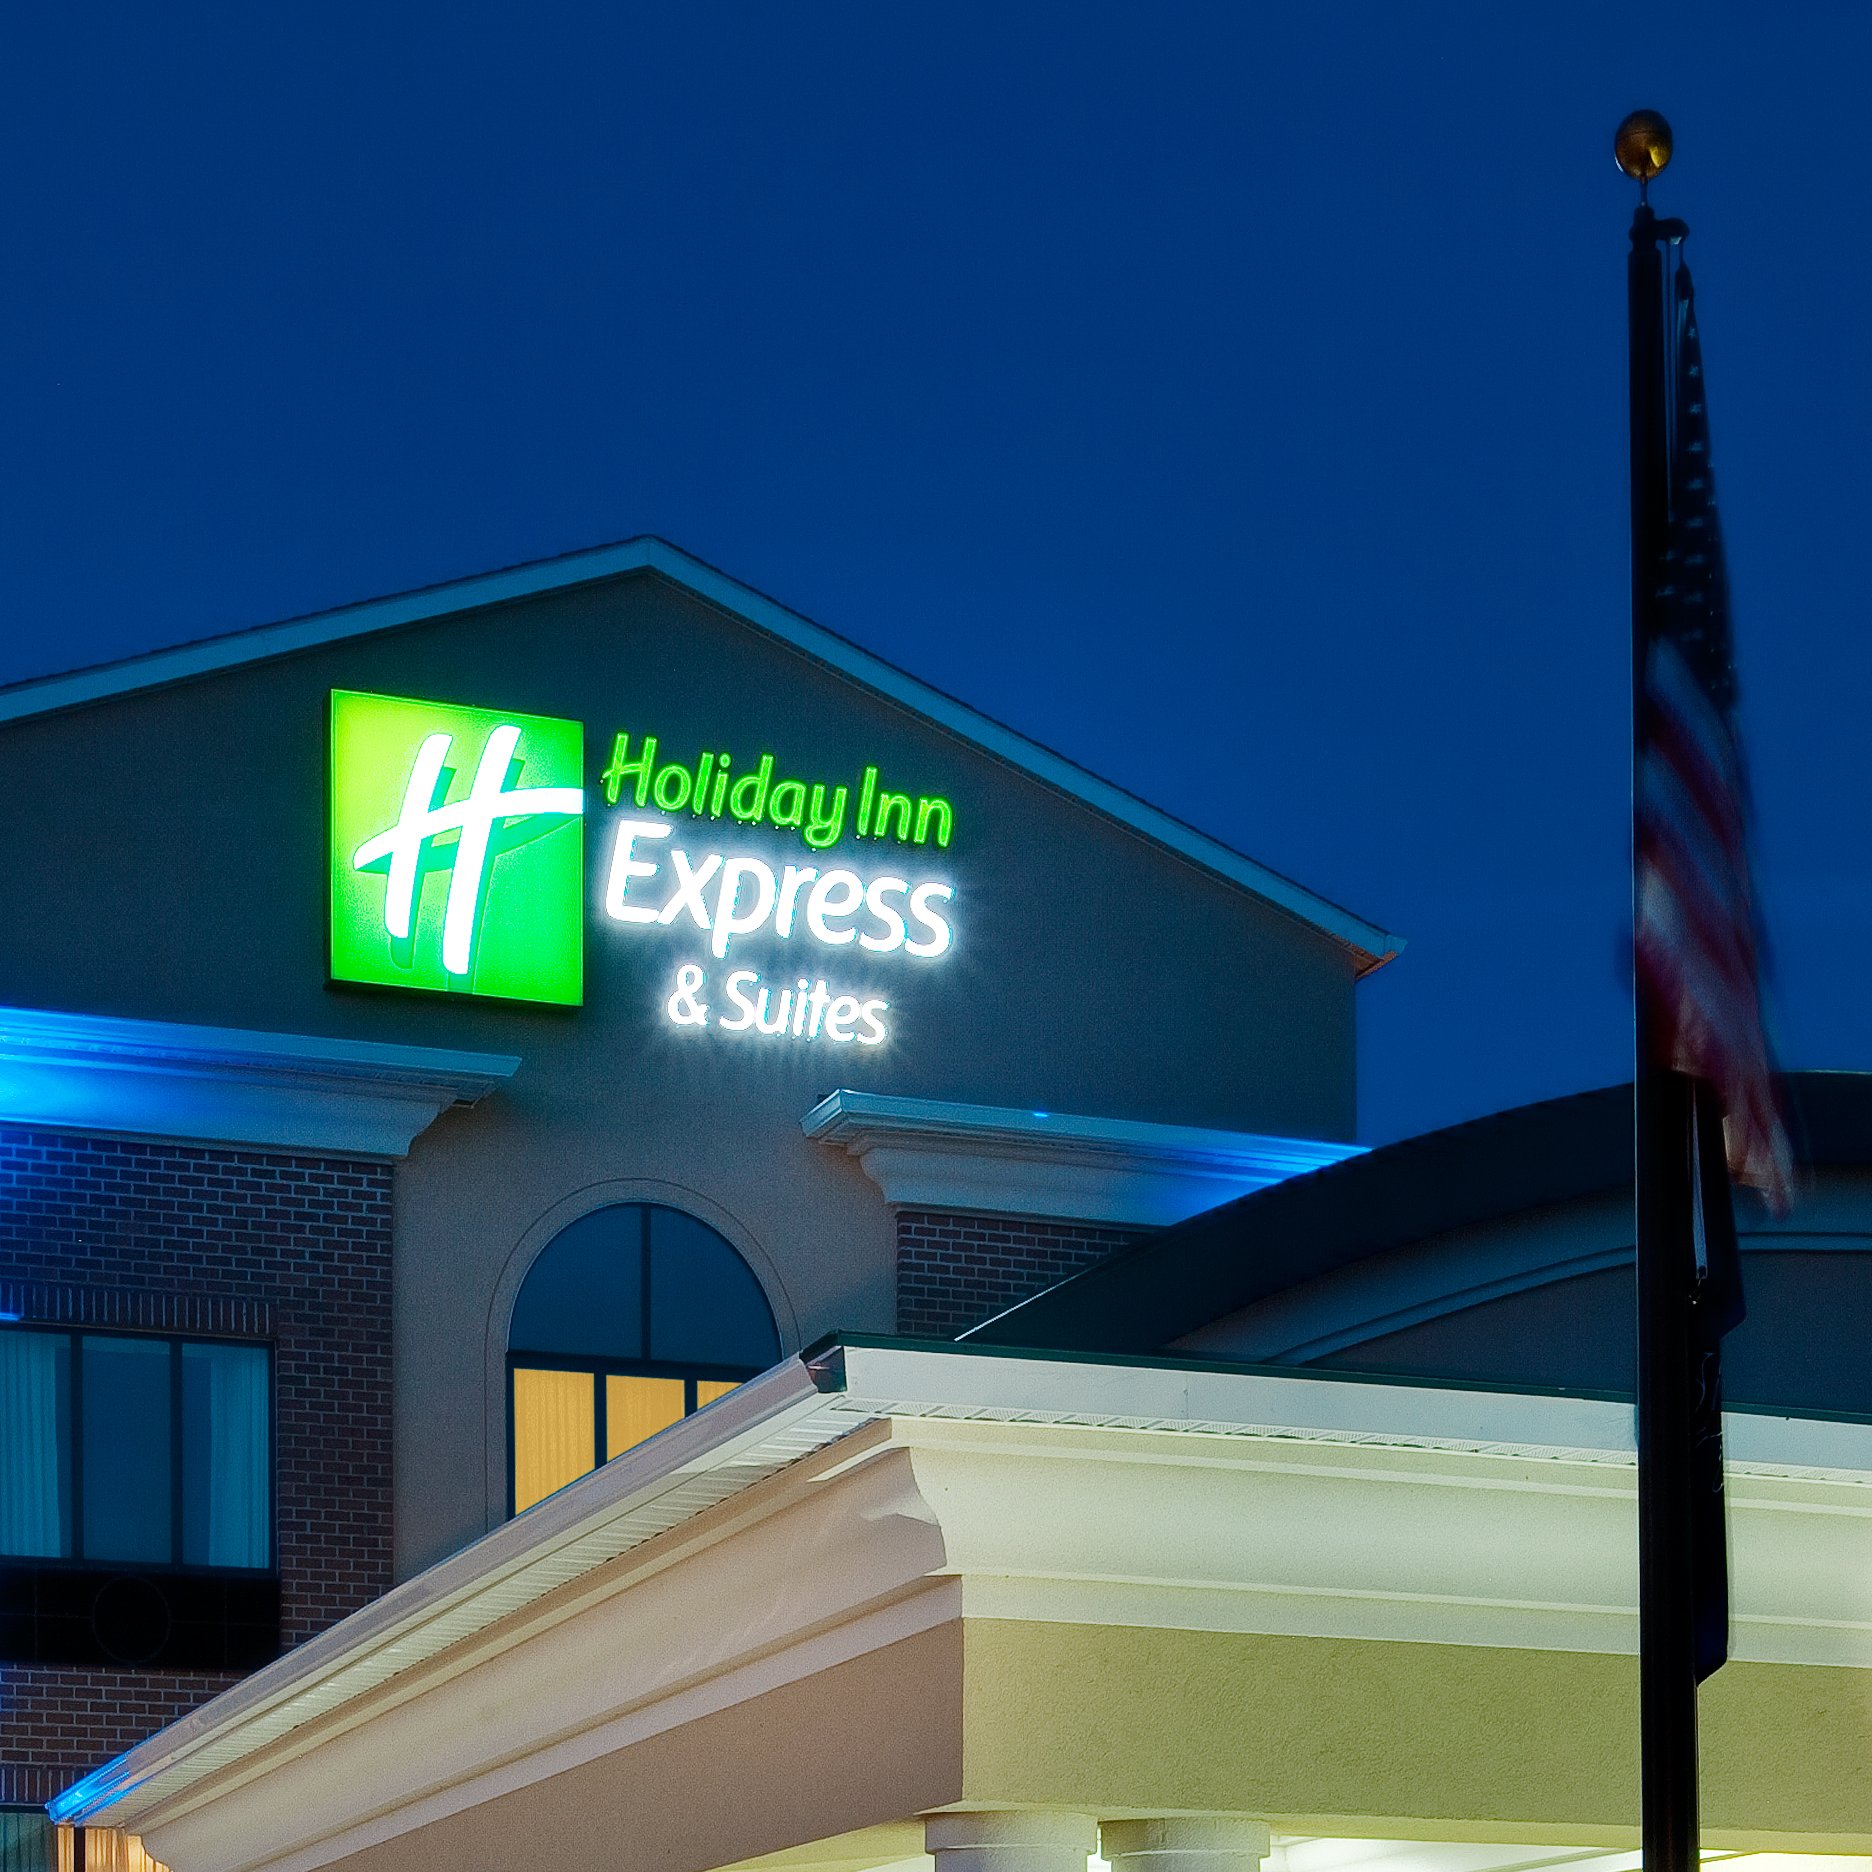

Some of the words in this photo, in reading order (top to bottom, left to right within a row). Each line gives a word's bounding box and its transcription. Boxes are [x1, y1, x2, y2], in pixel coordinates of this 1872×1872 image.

[602, 732, 848, 848] Holiday
[856, 766, 953, 848] Inn
[605, 819, 956, 959] Express
[667, 963, 709, 1026] &
[719, 969, 891, 1045] Suites
